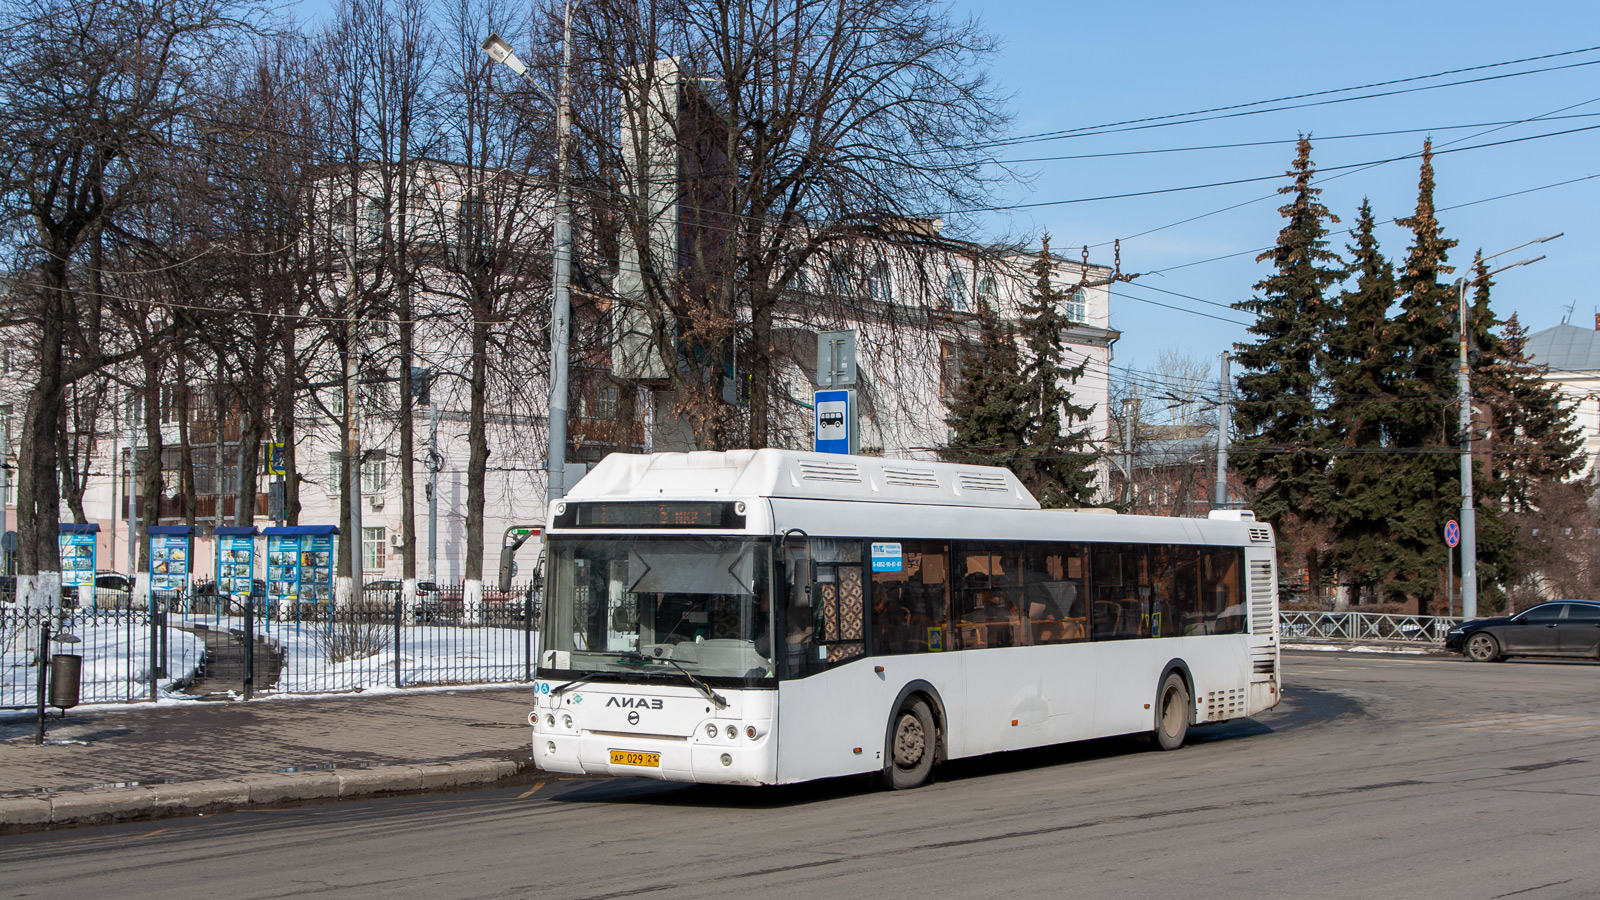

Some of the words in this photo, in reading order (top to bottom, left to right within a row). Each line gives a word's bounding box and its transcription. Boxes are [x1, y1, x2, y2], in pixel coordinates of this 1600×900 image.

[547, 651, 557, 669] 1
[605, 696, 664, 710] ЛИАЗ
[627, 753, 643, 764] 029
